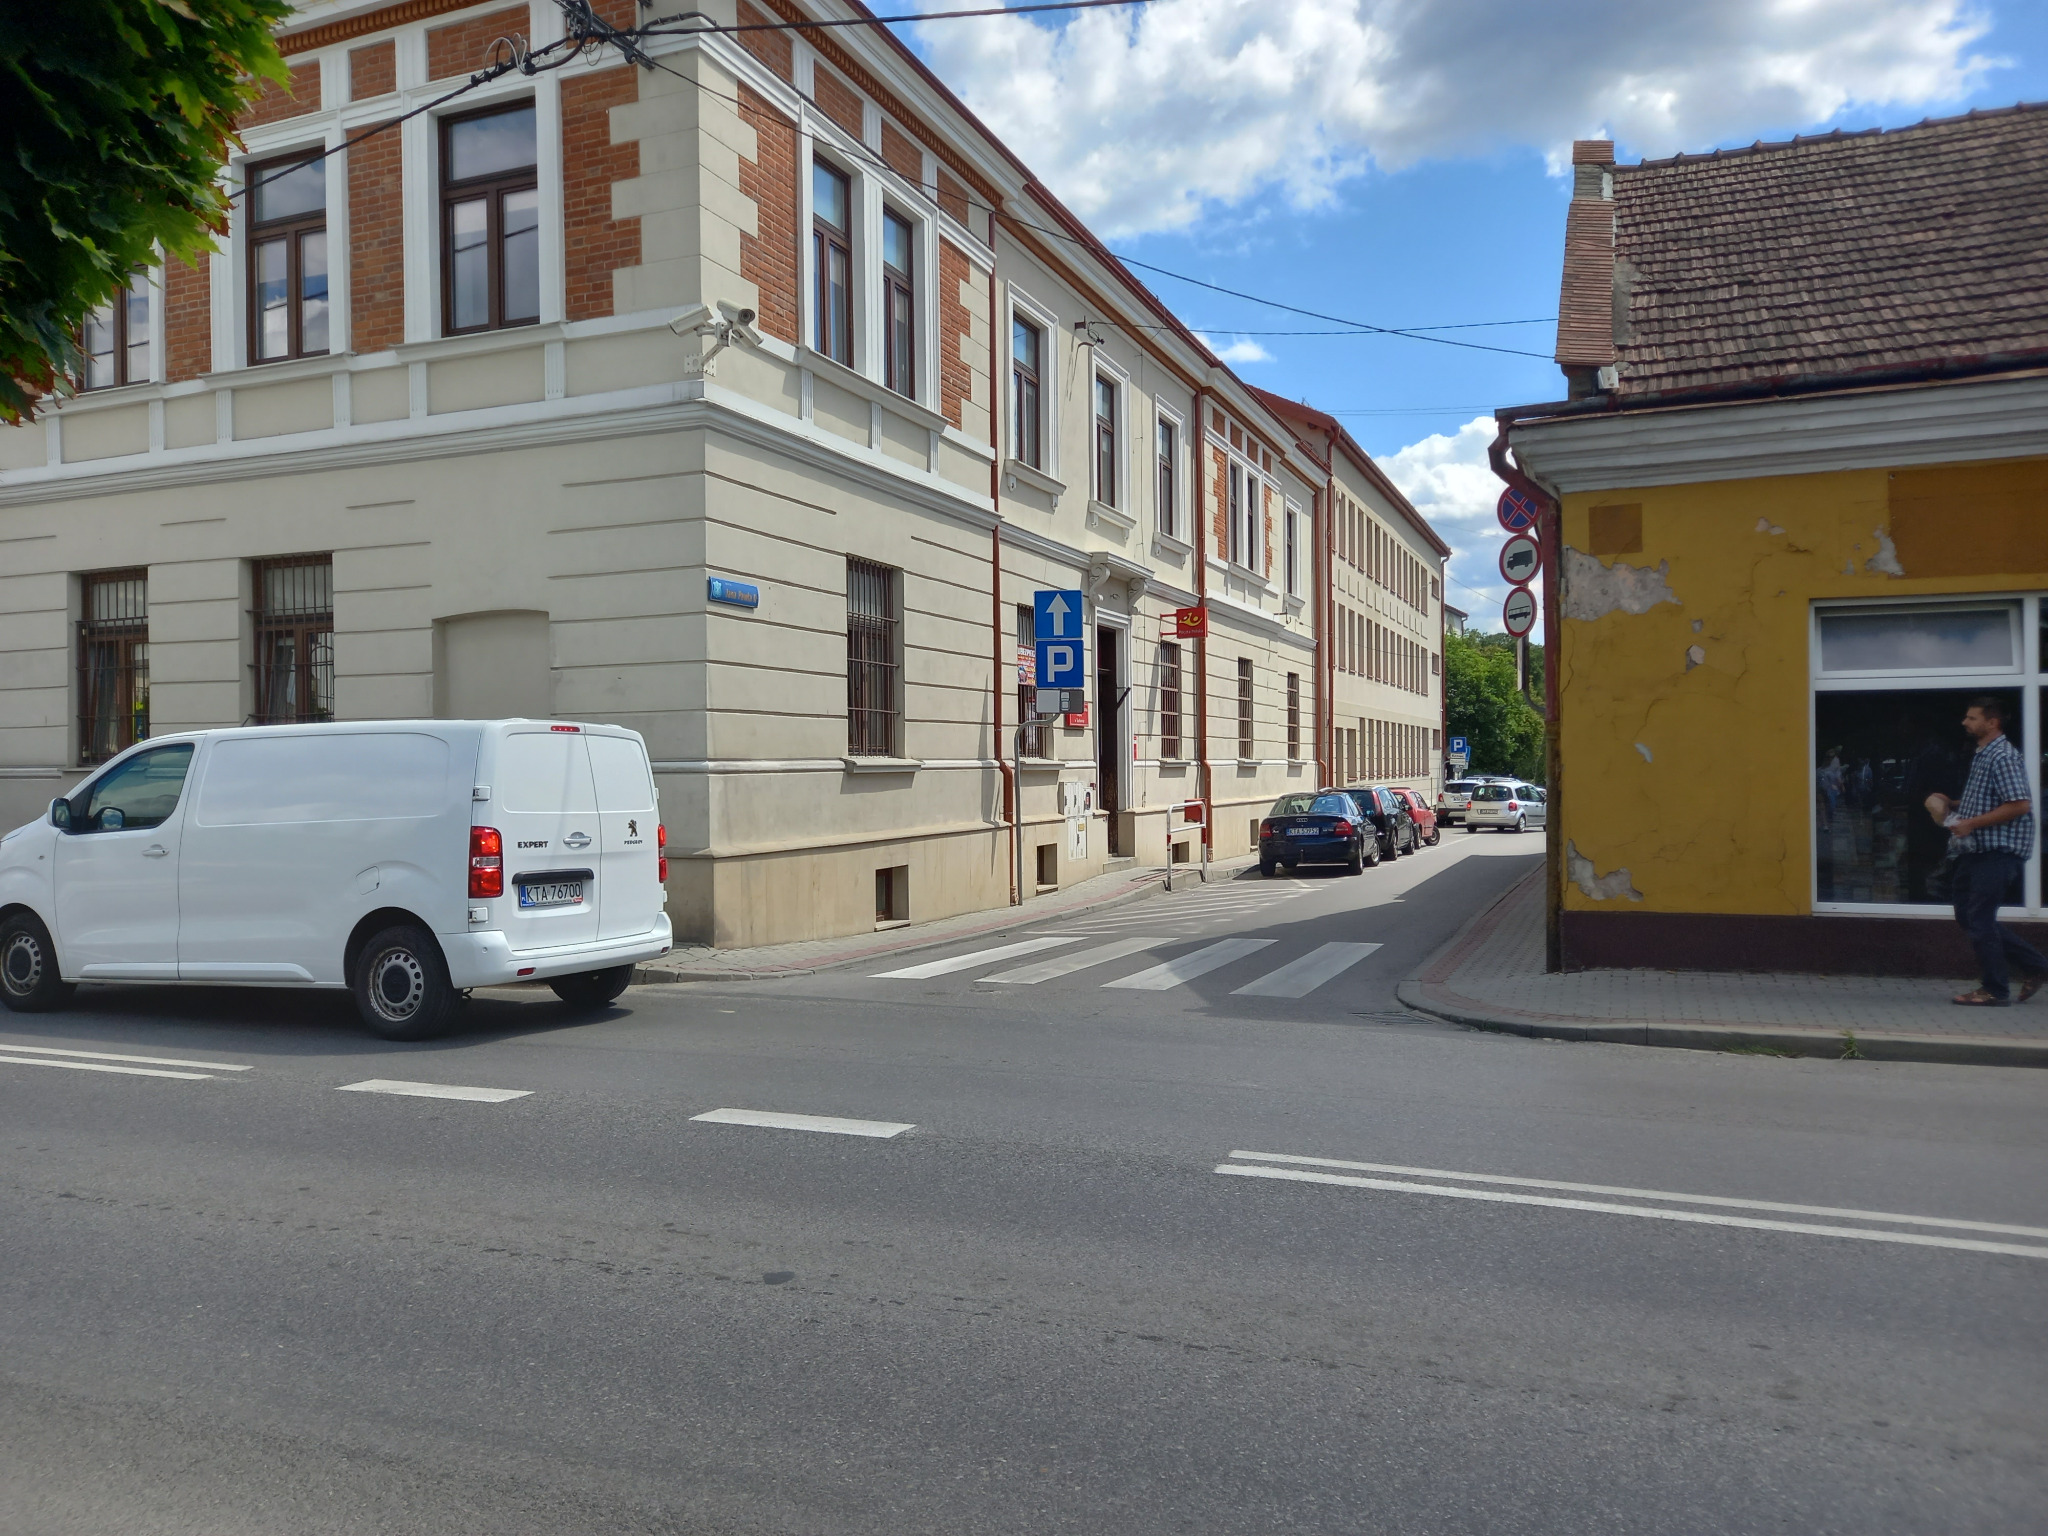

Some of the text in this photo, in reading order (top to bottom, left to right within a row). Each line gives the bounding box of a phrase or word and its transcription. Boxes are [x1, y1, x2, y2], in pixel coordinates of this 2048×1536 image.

[1047, 645, 1074, 683] P
[1453, 739, 1464, 751] P
[517, 840, 549, 849] EXPERT
[526, 883, 581, 902] KTA 76700
